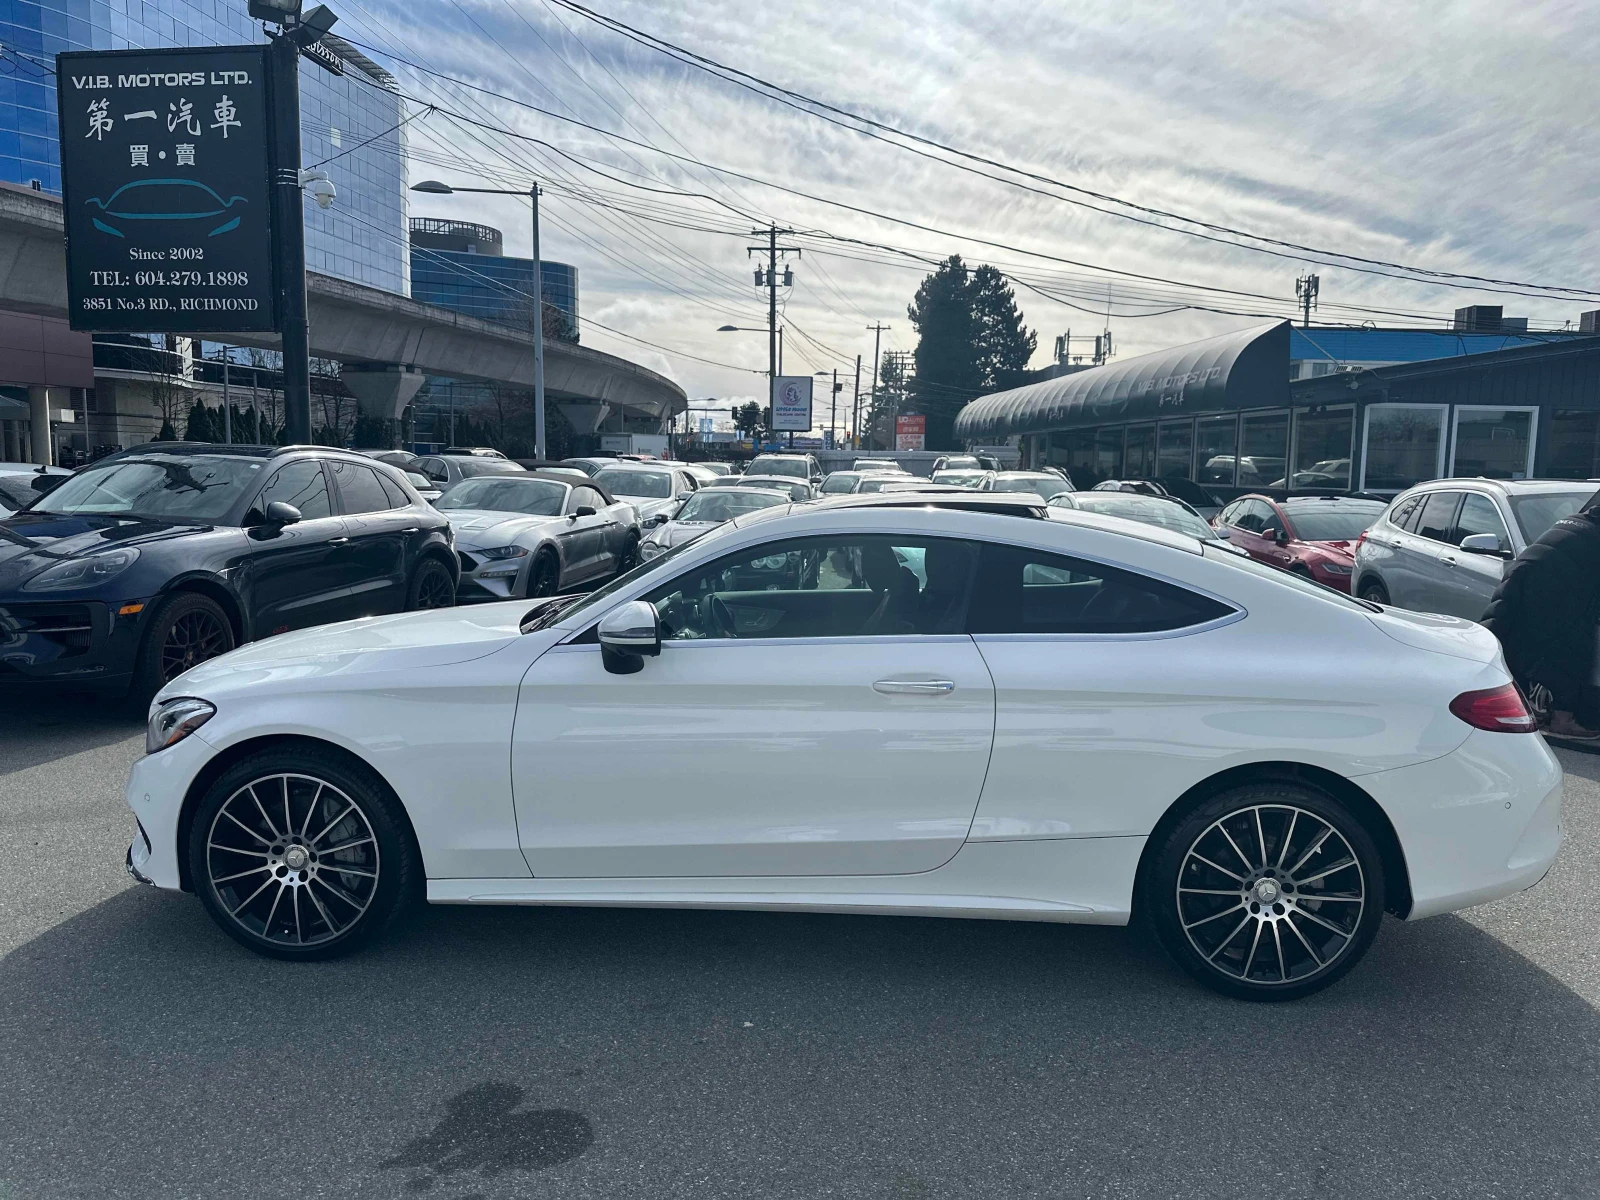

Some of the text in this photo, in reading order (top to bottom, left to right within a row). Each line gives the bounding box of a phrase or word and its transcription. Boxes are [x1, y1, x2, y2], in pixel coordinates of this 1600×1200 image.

[72, 71, 252, 89] V.I.B. MOTORS LTD.
[85, 95, 242, 141] 第一汽車
[129, 247, 204, 260] Since 2002
[90, 270, 249, 287] TEL: 604.279.1898
[83, 298, 259, 313] 3851 No.3 RD., RICHMOND
